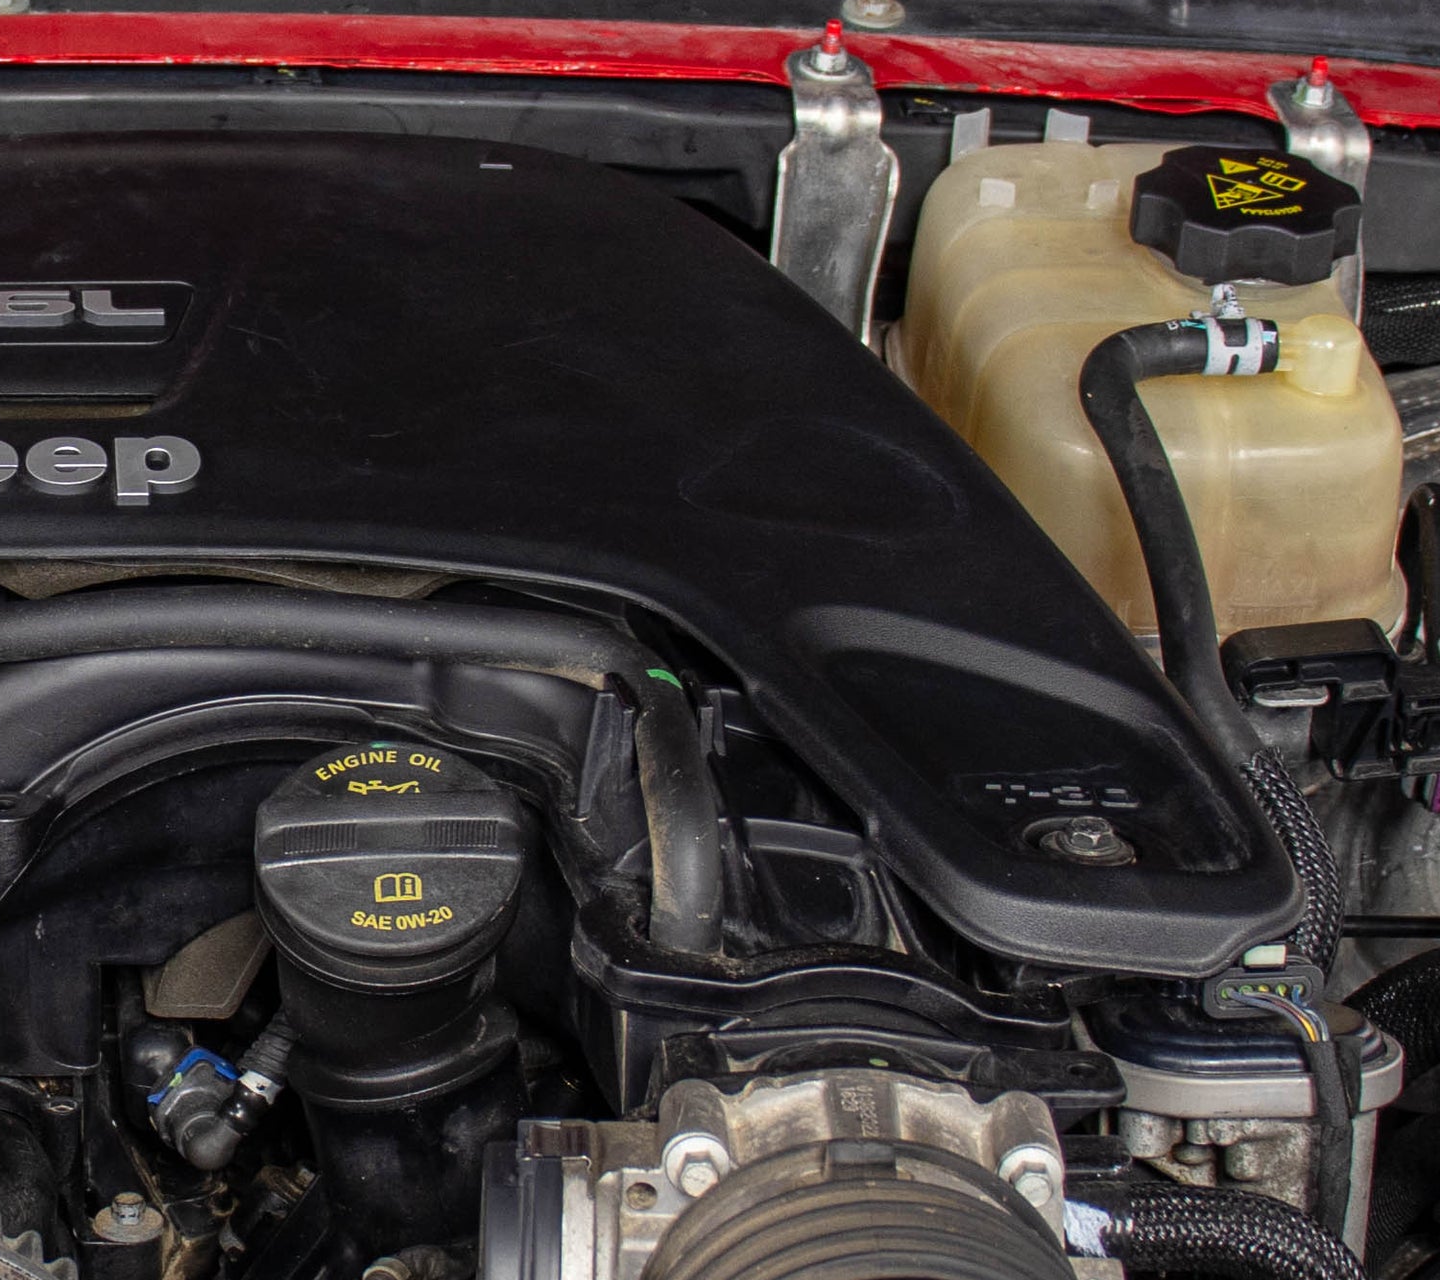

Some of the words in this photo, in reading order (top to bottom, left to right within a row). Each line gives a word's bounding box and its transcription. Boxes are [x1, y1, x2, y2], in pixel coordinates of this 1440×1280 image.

[315, 750, 398, 782] ENGINE
[409, 752, 442, 773] OIL
[350, 910, 393, 931] SAE
[395, 905, 454, 930] 0W-20
